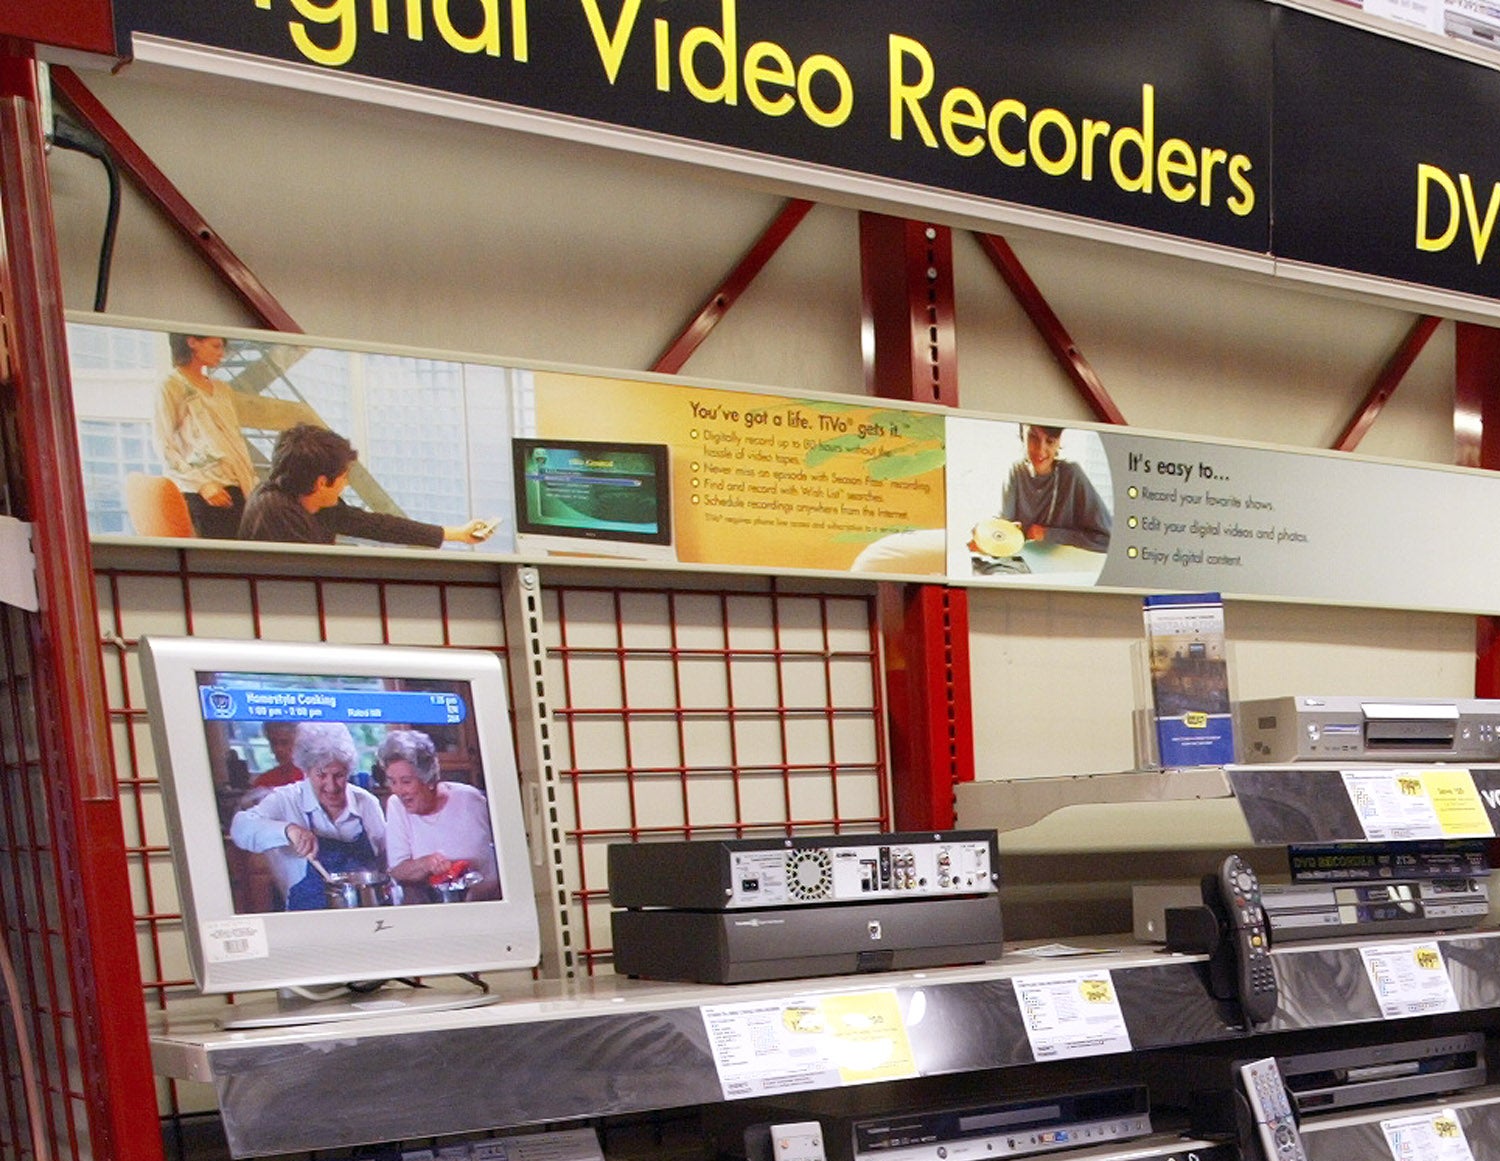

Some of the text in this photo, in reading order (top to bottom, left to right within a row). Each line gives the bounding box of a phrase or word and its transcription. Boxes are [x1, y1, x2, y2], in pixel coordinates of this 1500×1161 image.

[581, 0, 854, 128] Video
[888, 33, 1256, 217] Recorders
[689, 401, 740, 422] You've
[744, 412, 768, 427] got
[773, 415, 783, 426] a
[787, 410, 813, 430] life.
[1128, 451, 1151, 473] It's
[1157, 460, 1194, 482] easy
[1141, 486, 1178, 504] Record
[1179, 491, 1203, 507] your
[1205, 491, 1241, 508] favorite
[1141, 516, 1161, 531] Edit
[1164, 521, 1187, 536] your
[1189, 520, 1221, 539] digital
[1223, 523, 1254, 539] videos
[1255, 526, 1274, 540] and
[1141, 546, 1169, 566] Enjoy
[1171, 549, 1204, 567] digital
